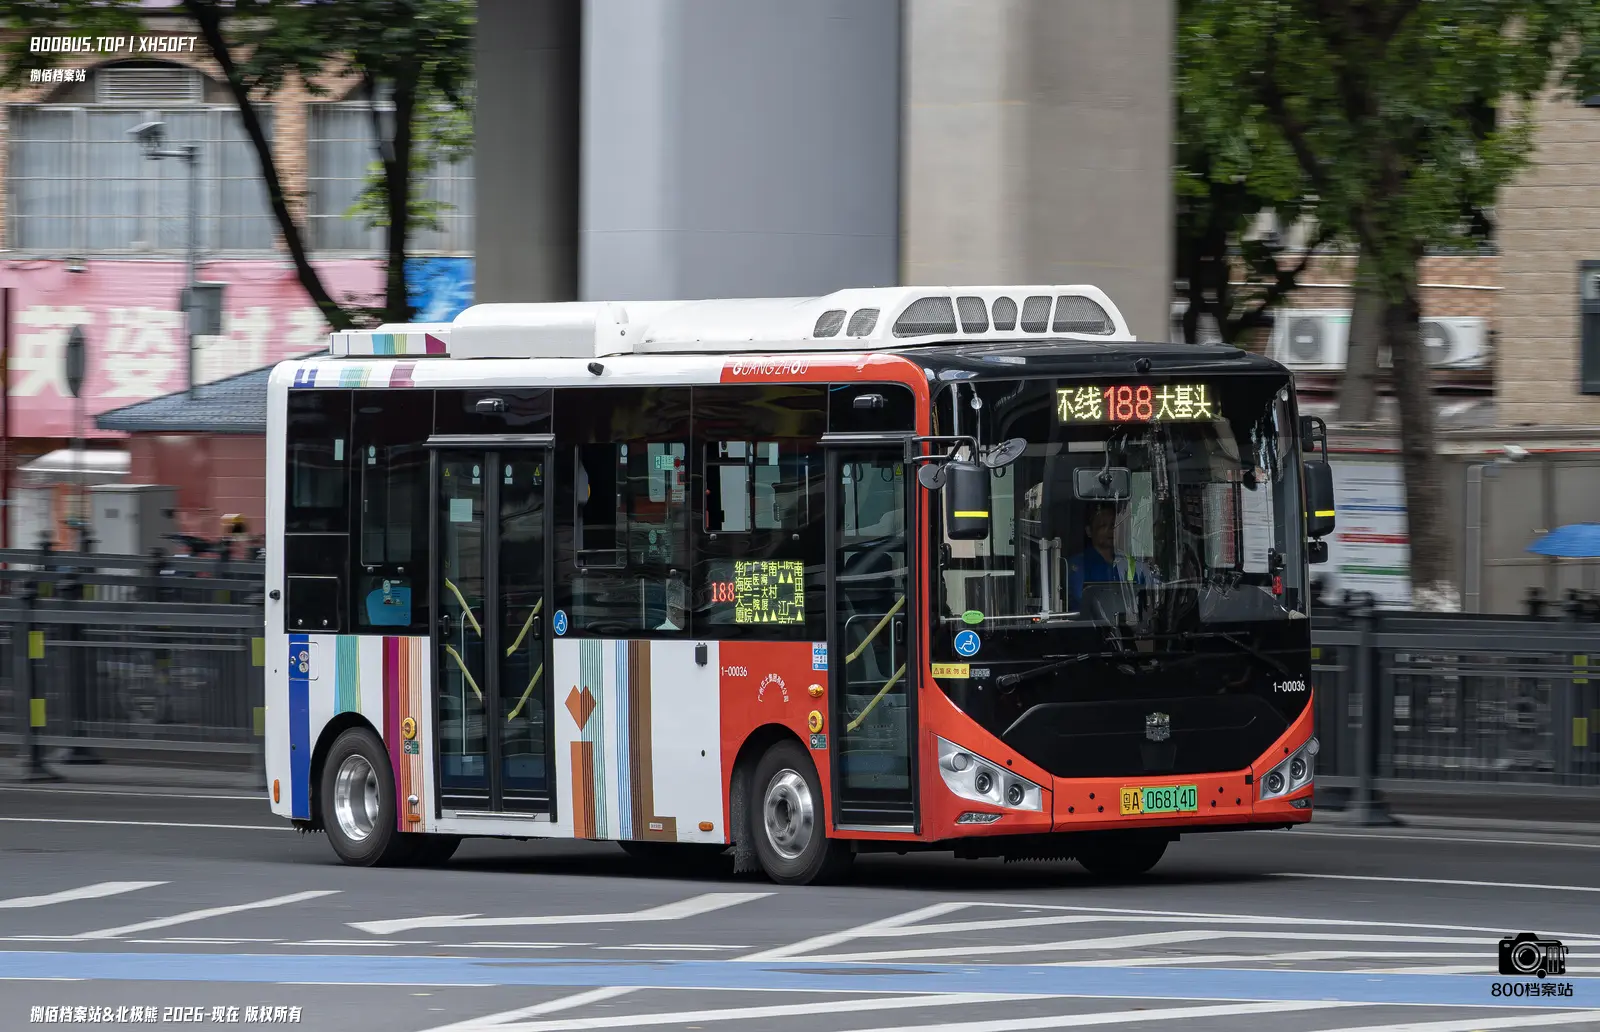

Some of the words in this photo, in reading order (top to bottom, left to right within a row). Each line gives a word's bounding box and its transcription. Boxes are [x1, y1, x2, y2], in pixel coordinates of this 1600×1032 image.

[732, 359, 810, 376] GUANGZHOU
[1103, 384, 1153, 421] 188
[1155, 384, 1212, 419] 大基头
[711, 582, 735, 603] 188
[720, 665, 748, 677] 1-00036
[1272, 680, 1306, 693] 1-00036
[1146, 788, 1197, 810] 06814D
